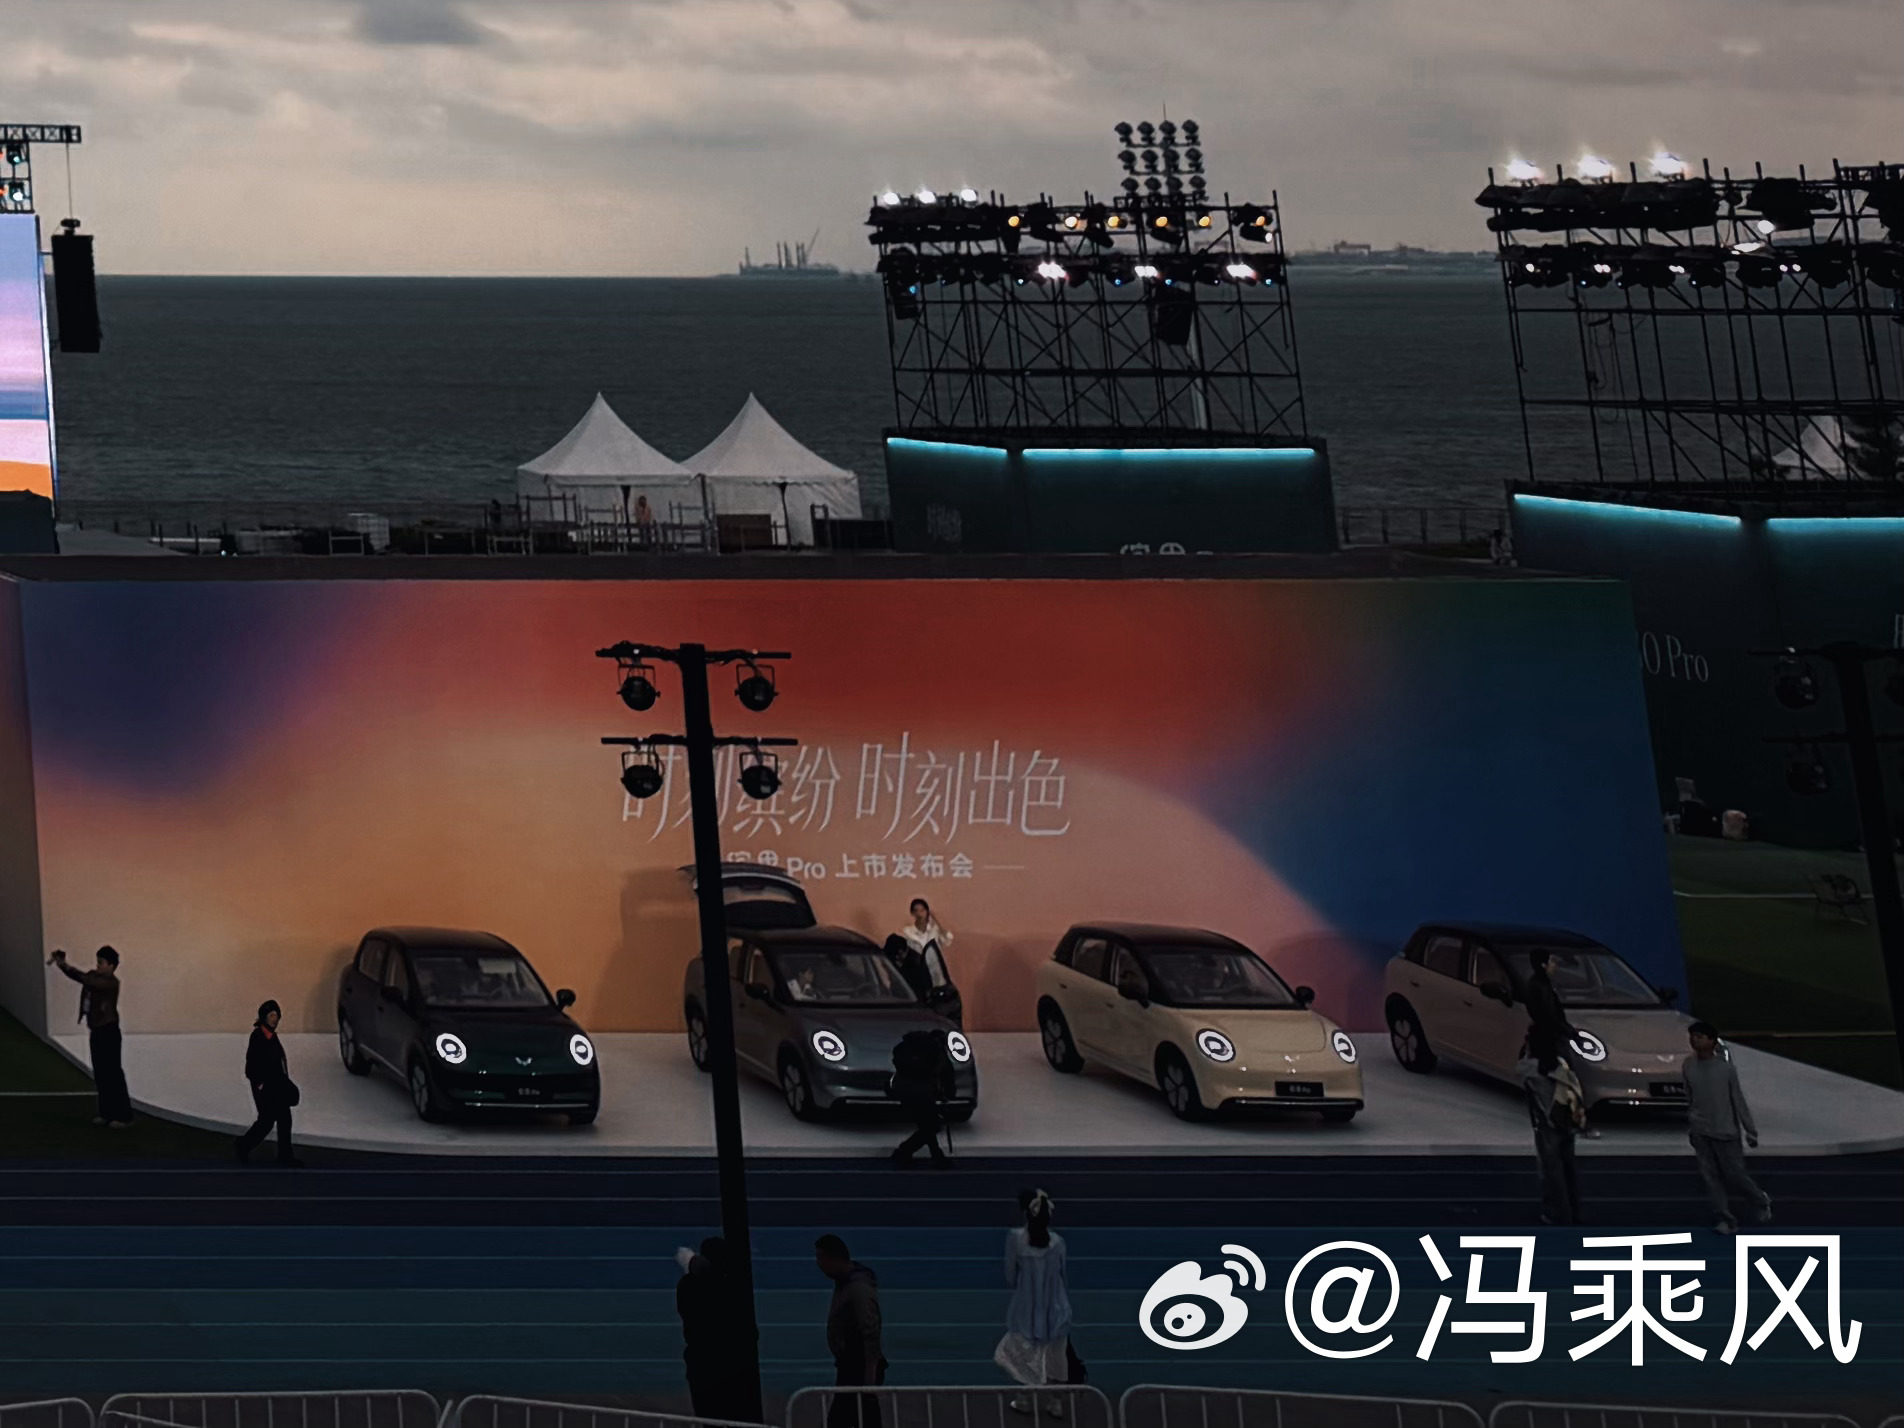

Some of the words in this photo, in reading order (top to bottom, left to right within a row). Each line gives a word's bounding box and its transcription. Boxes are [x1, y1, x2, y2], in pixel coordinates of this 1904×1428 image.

[1665, 633, 1710, 683] Pro
[855, 731, 1071, 845] 时刻出色
[835, 852, 974, 880] 上市发布会
